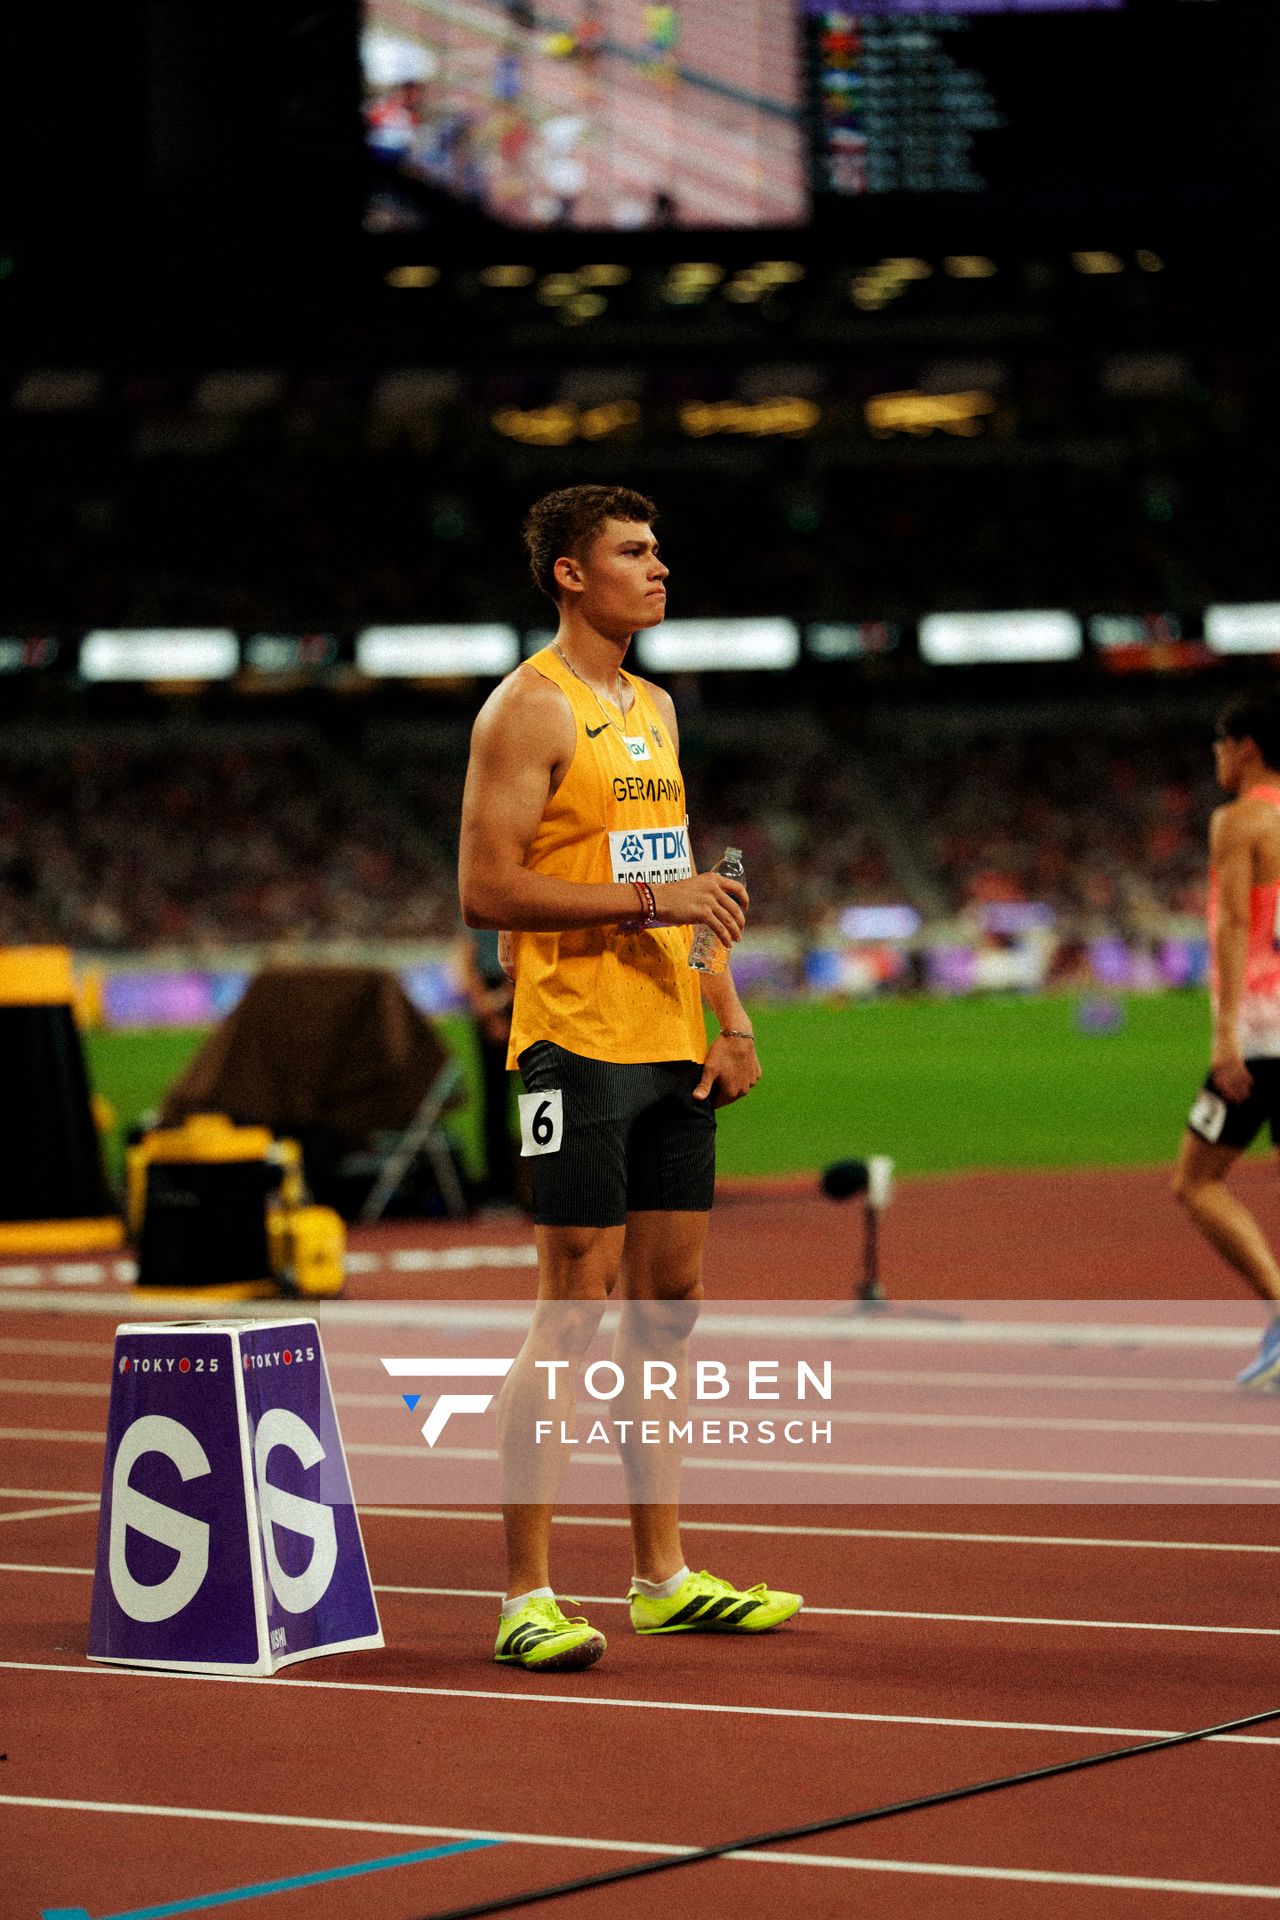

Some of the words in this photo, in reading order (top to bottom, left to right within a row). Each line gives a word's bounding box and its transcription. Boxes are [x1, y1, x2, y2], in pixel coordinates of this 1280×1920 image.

[613, 777, 682, 802] GERMANY
[643, 831, 687, 861] TDK
[532, 1100, 554, 1146] 6
[109, 1414, 212, 1623] 6
[255, 1408, 338, 1614] 6
